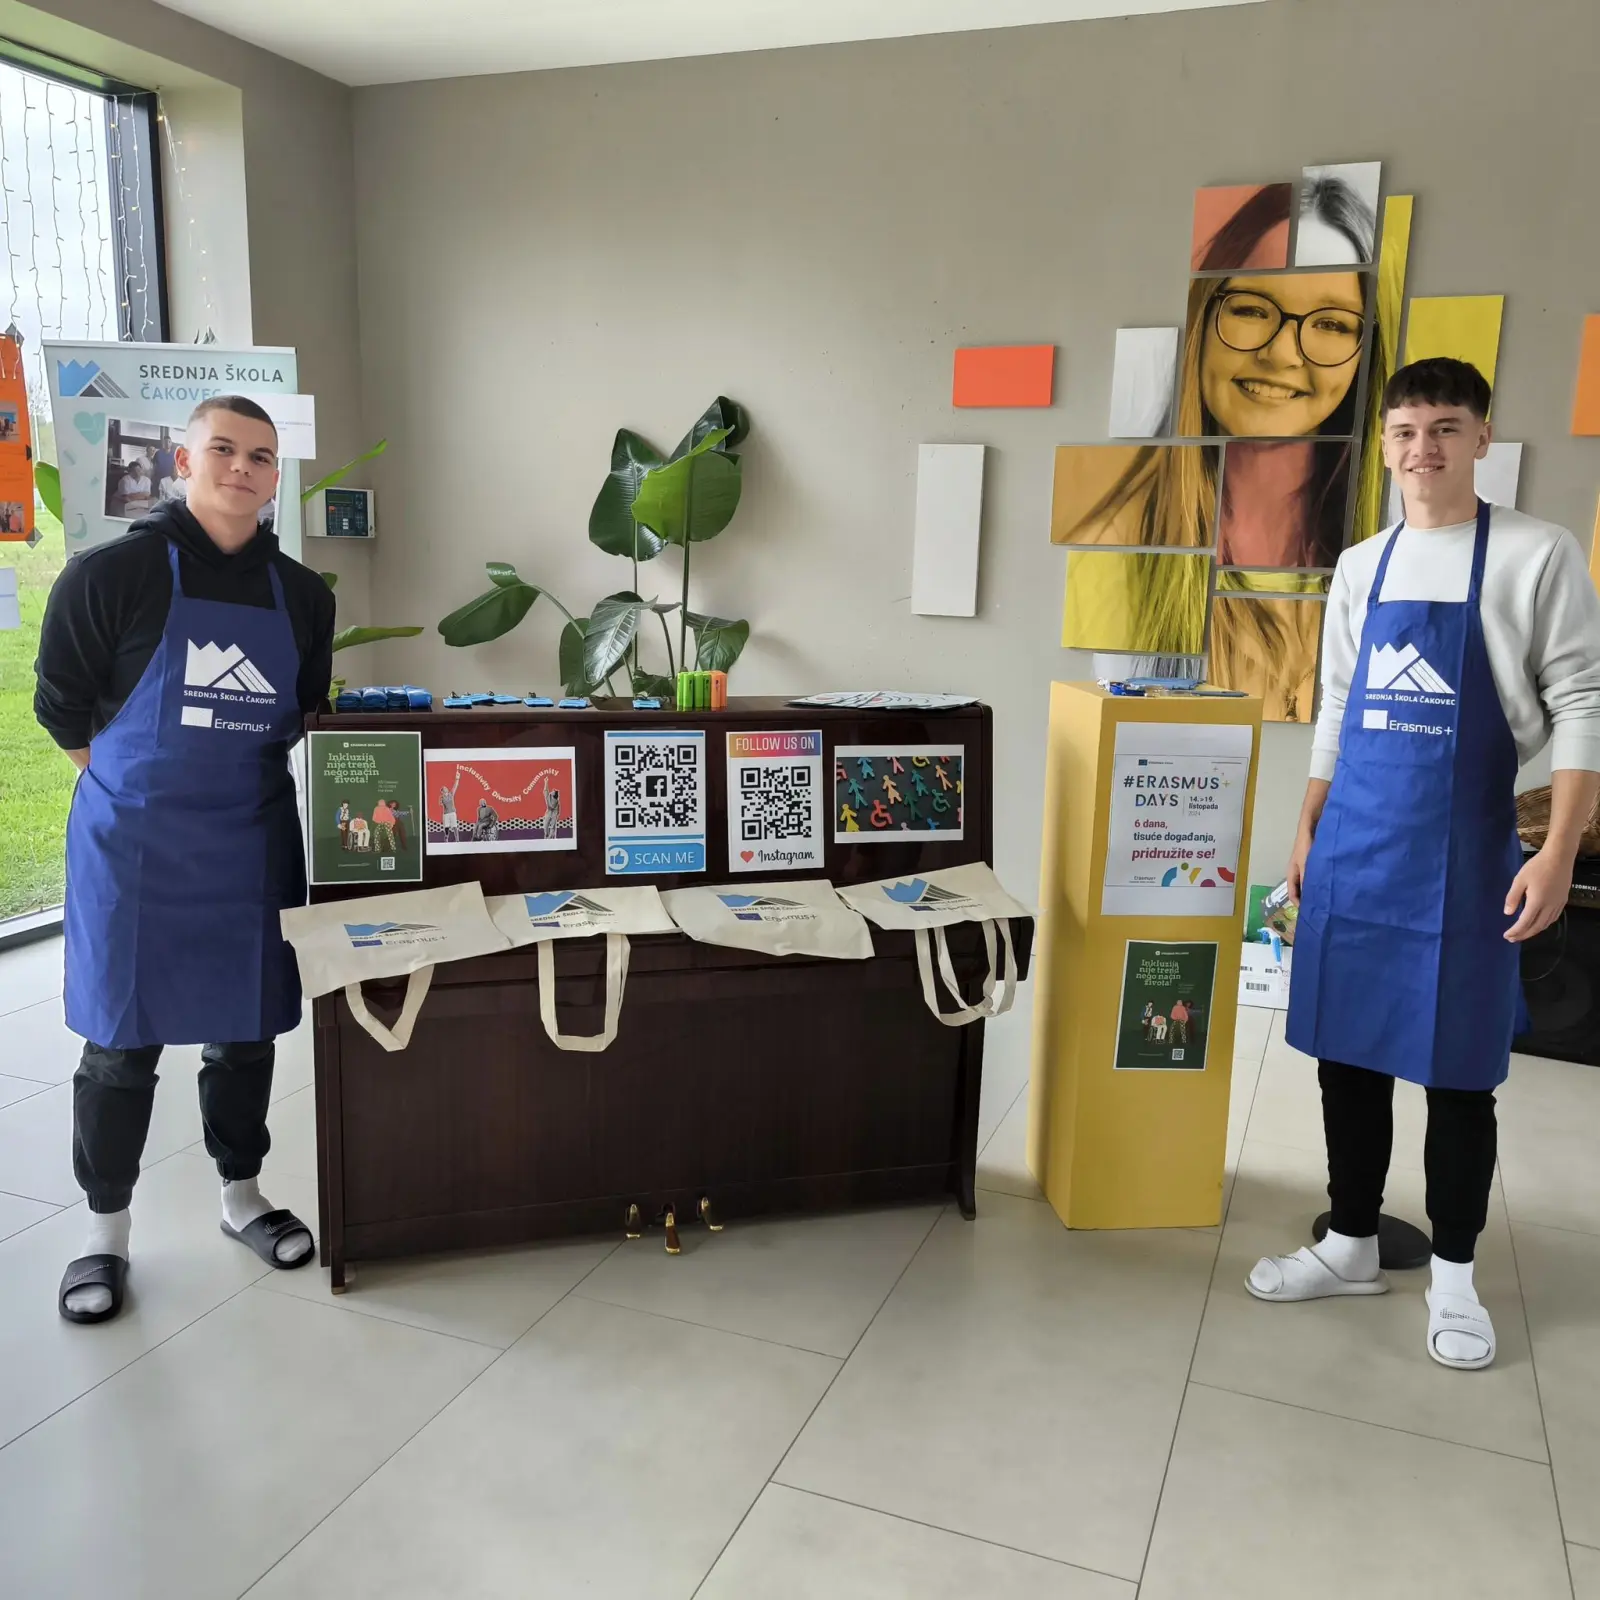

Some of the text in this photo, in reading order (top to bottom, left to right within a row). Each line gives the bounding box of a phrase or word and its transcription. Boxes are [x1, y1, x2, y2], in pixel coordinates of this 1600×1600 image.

[139, 364, 284, 383] SREDNJA ŠKOLA
[183, 690, 276, 704] SREDNJA ŠKOLA ČAKOVEC
[1365, 693, 1456, 706] SREDNJA ŠKOLA ČAKOVEC
[214, 718, 272, 732] Erasmus+
[1389, 719, 1453, 735] Erasmus+
[735, 736, 815, 751] FOLLOW US ON
[328, 752, 375, 764] Inkluzija
[326, 760, 376, 771] nije trend
[323, 768, 380, 778] nego način
[334, 775, 369, 784] života!
[456, 764, 560, 803] Inclusivity Diversity Community
[1135, 793, 1179, 807] DAYS
[1188, 802, 1219, 810] listopada
[1134, 818, 1168, 829] 6 dana,
[1133, 831, 1216, 844] tisuće događanja,
[634, 851, 695, 865] SCAN ME
[758, 849, 815, 865] Instagram
[1131, 846, 1216, 861] pridružite se!
[1139, 966, 1180, 975] nije trend
[1141, 959, 1180, 970] Inkluzija
[1136, 973, 1157, 981] nego
